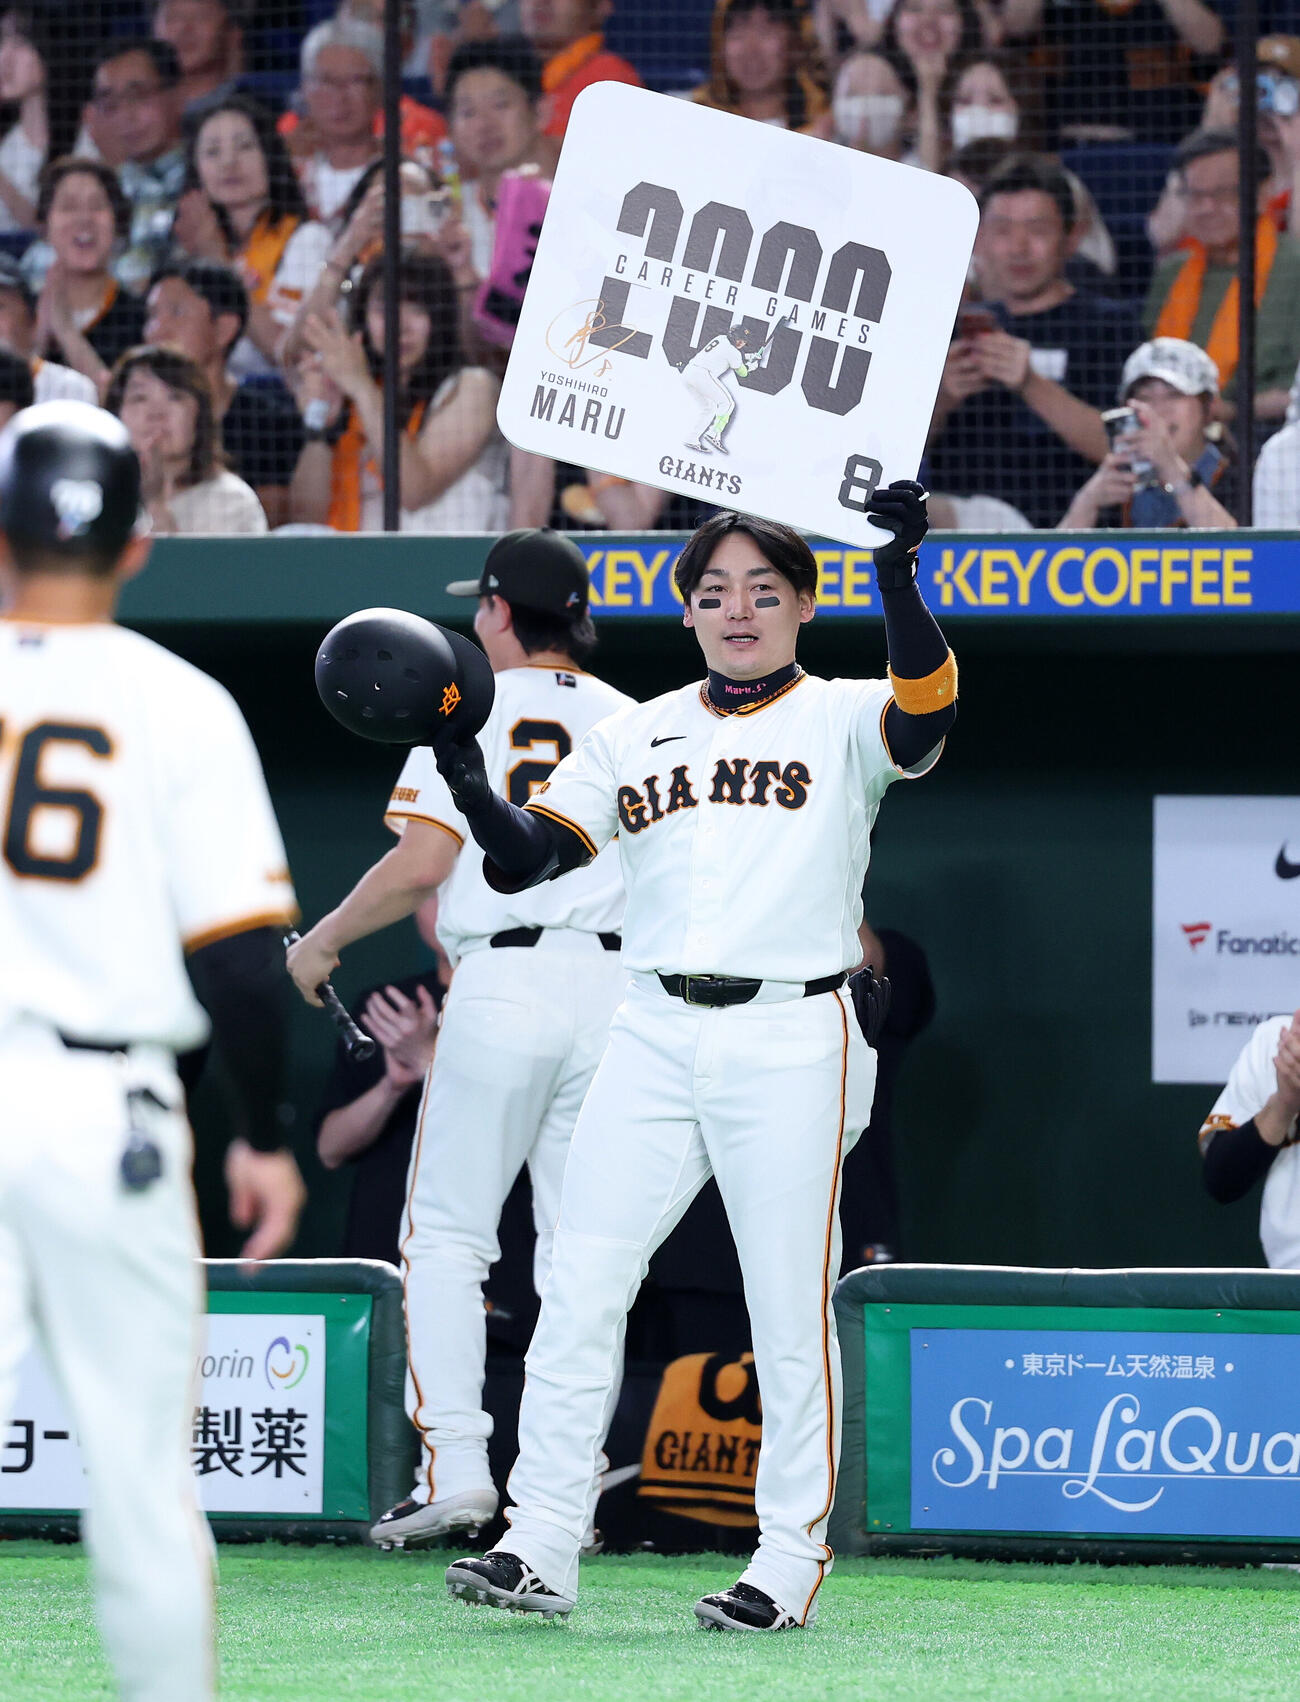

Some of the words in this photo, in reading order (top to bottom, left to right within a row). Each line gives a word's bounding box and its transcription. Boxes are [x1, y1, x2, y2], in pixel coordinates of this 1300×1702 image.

[615, 254, 738, 305] CAREER
[766, 297, 870, 344] GAMES
[530, 385, 626, 440] MARU
[541, 371, 608, 397] YOSHIHIRO
[659, 456, 742, 495] GIANTS
[838, 454, 883, 513] 8
[0, 711, 115, 885] 6
[617, 758, 812, 834] GIANTS
[1021, 1352, 1217, 1379] 東京ドーム天然温泉
[932, 1397, 1073, 1490] Spa
[1062, 1393, 1300, 1512] LaQua
